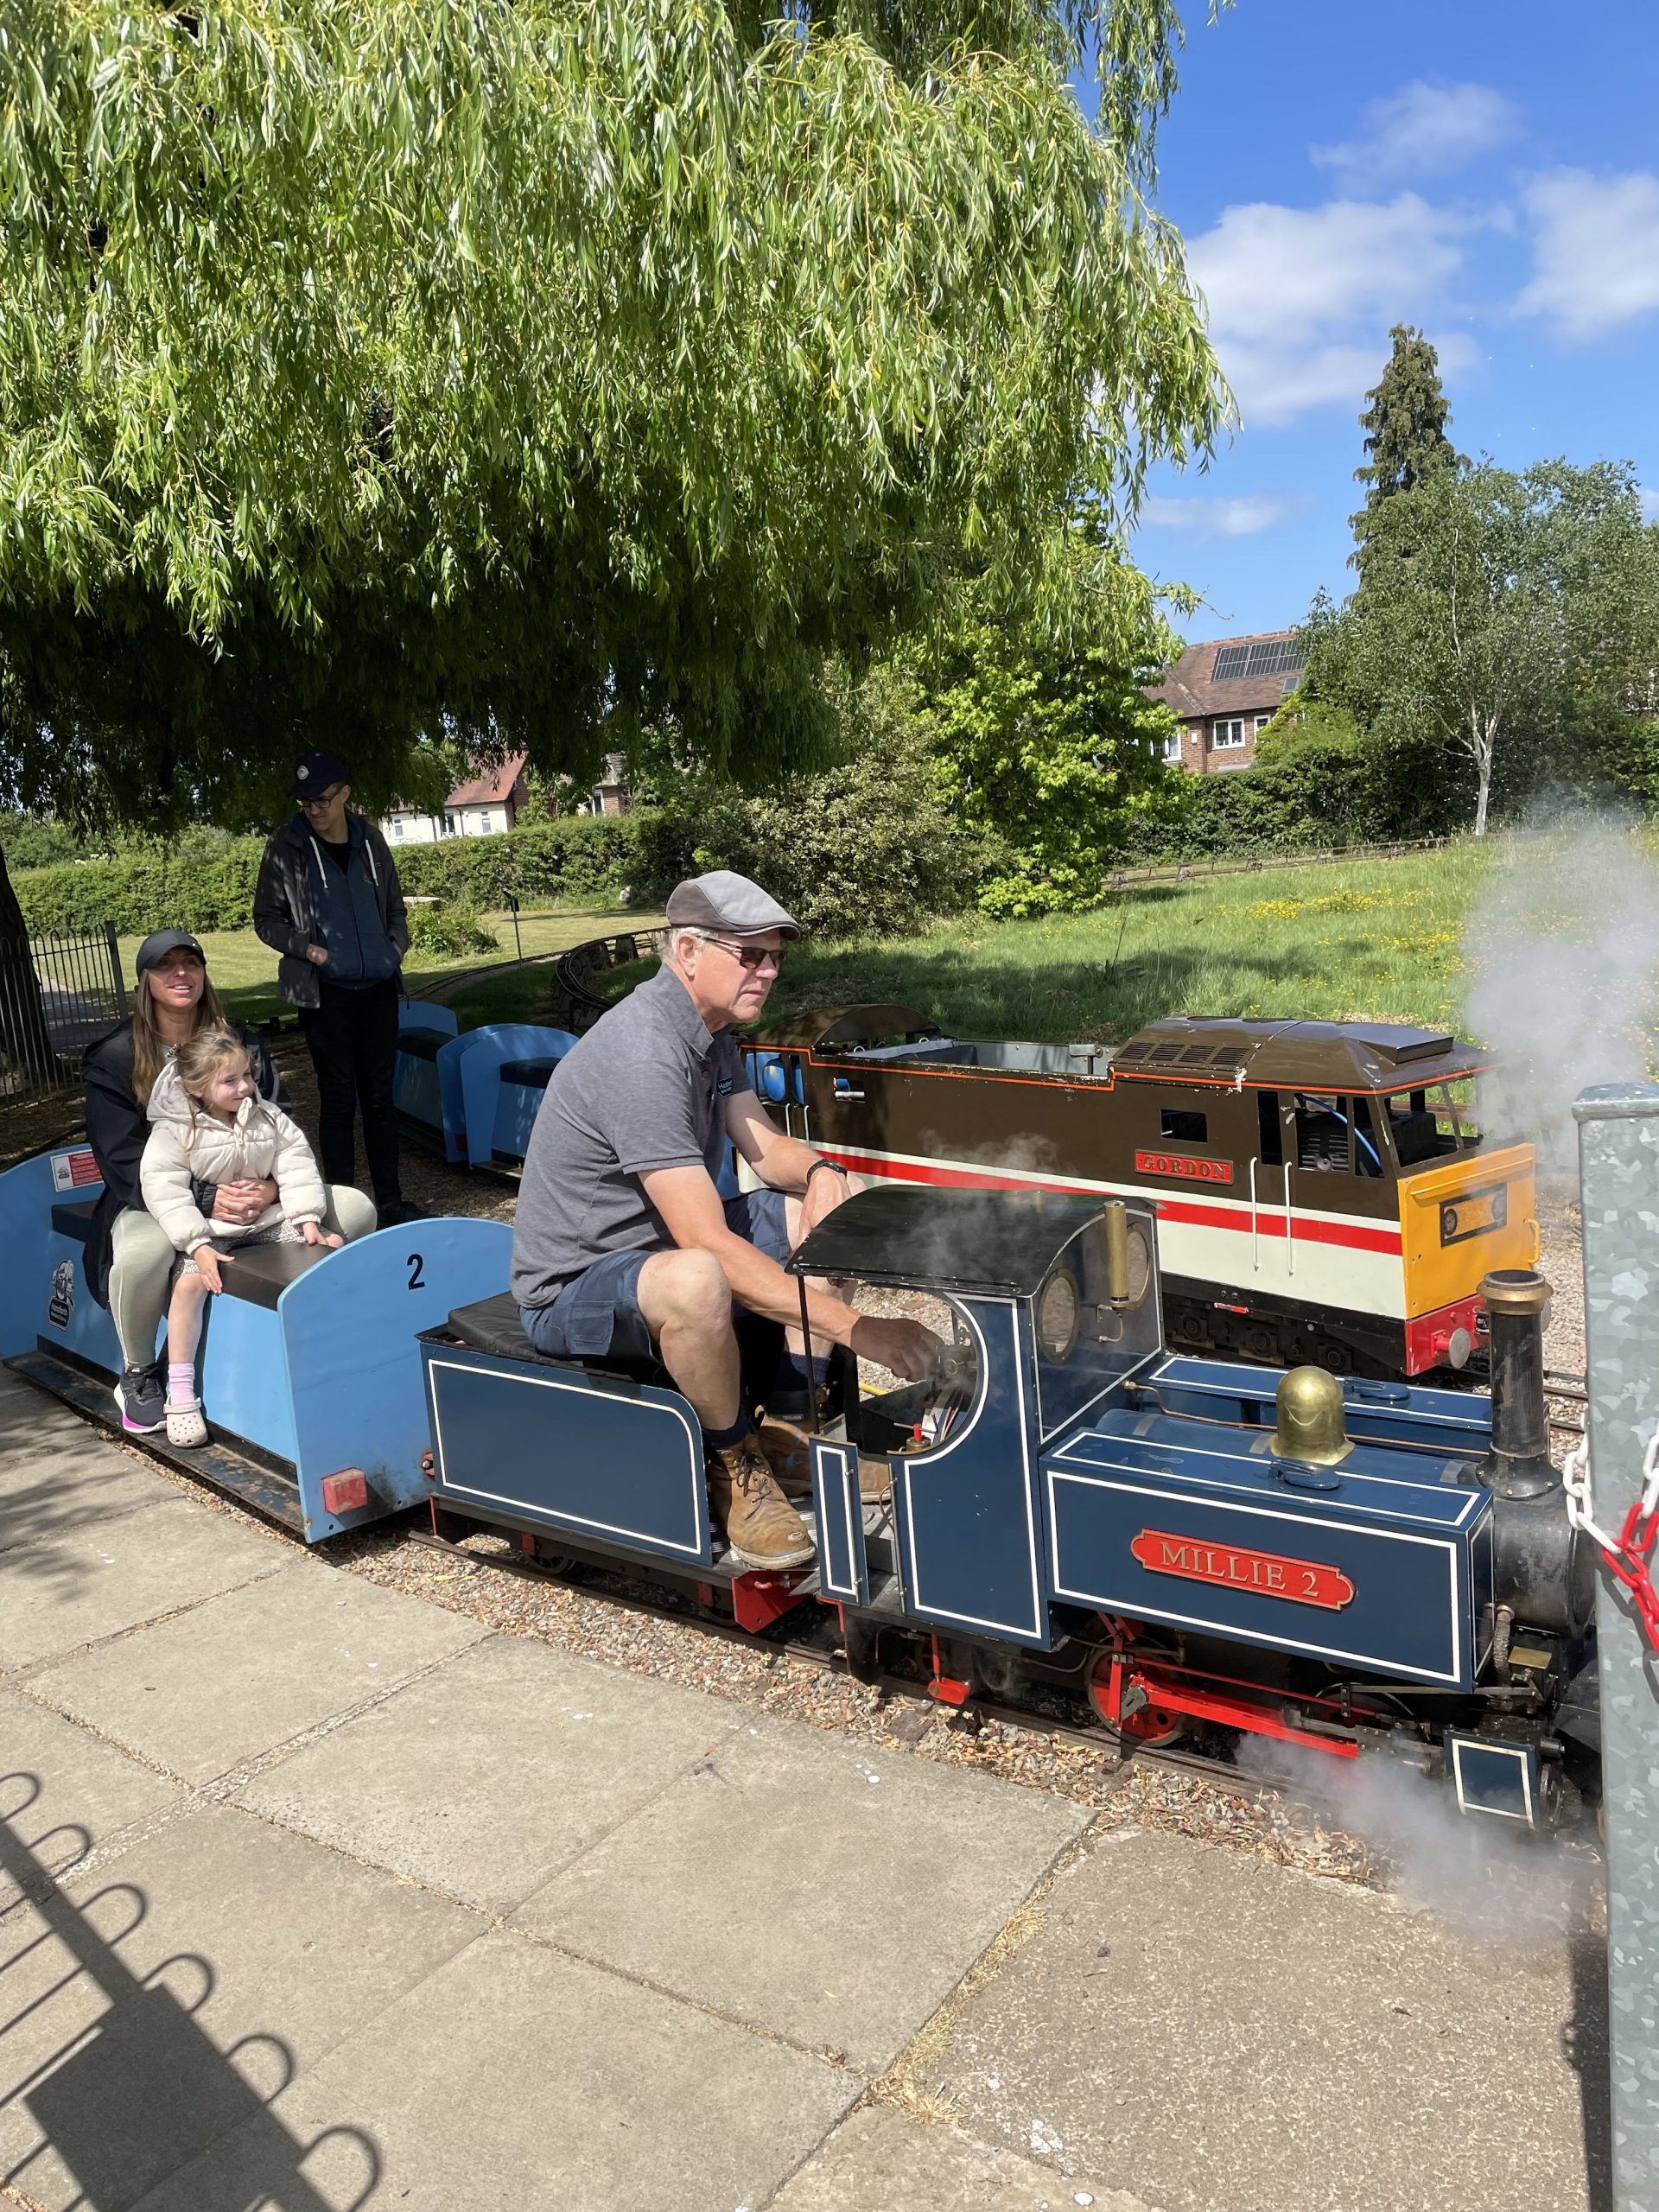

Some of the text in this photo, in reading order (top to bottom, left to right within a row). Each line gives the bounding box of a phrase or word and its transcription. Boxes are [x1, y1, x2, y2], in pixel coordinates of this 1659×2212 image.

[1143, 1154, 1227, 1179] GORDON
[407, 1253, 425, 1290] 2
[1160, 1541, 1319, 1598] MILLIE 2
